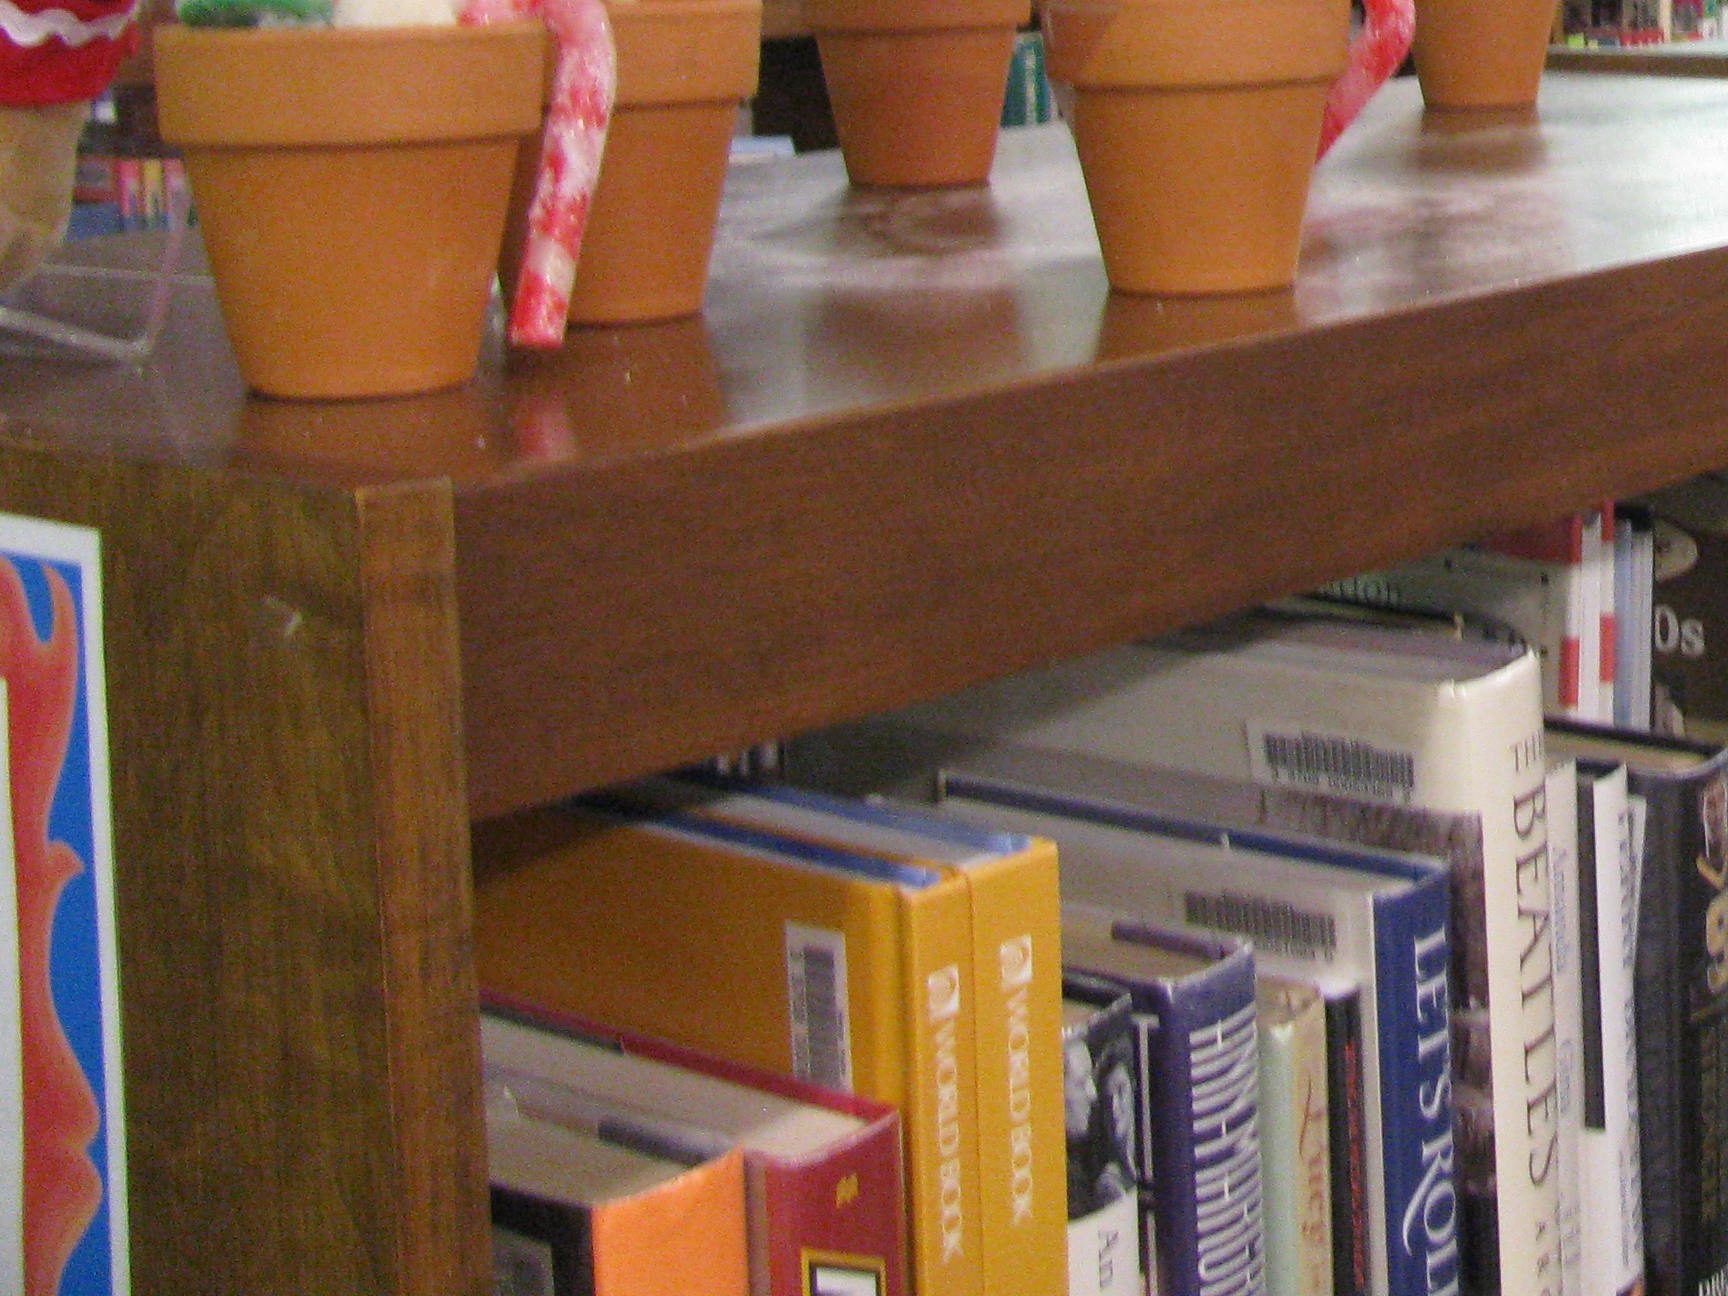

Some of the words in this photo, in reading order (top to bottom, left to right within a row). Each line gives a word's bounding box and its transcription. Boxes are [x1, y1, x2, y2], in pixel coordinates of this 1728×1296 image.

[1512, 774, 1558, 1186] BEATLES
[934, 1016, 960, 1156] WORLD
[1006, 987, 1032, 1123] WORLD
[940, 1157, 964, 1266] BOOK
[1010, 1123, 1034, 1227] BOOK
